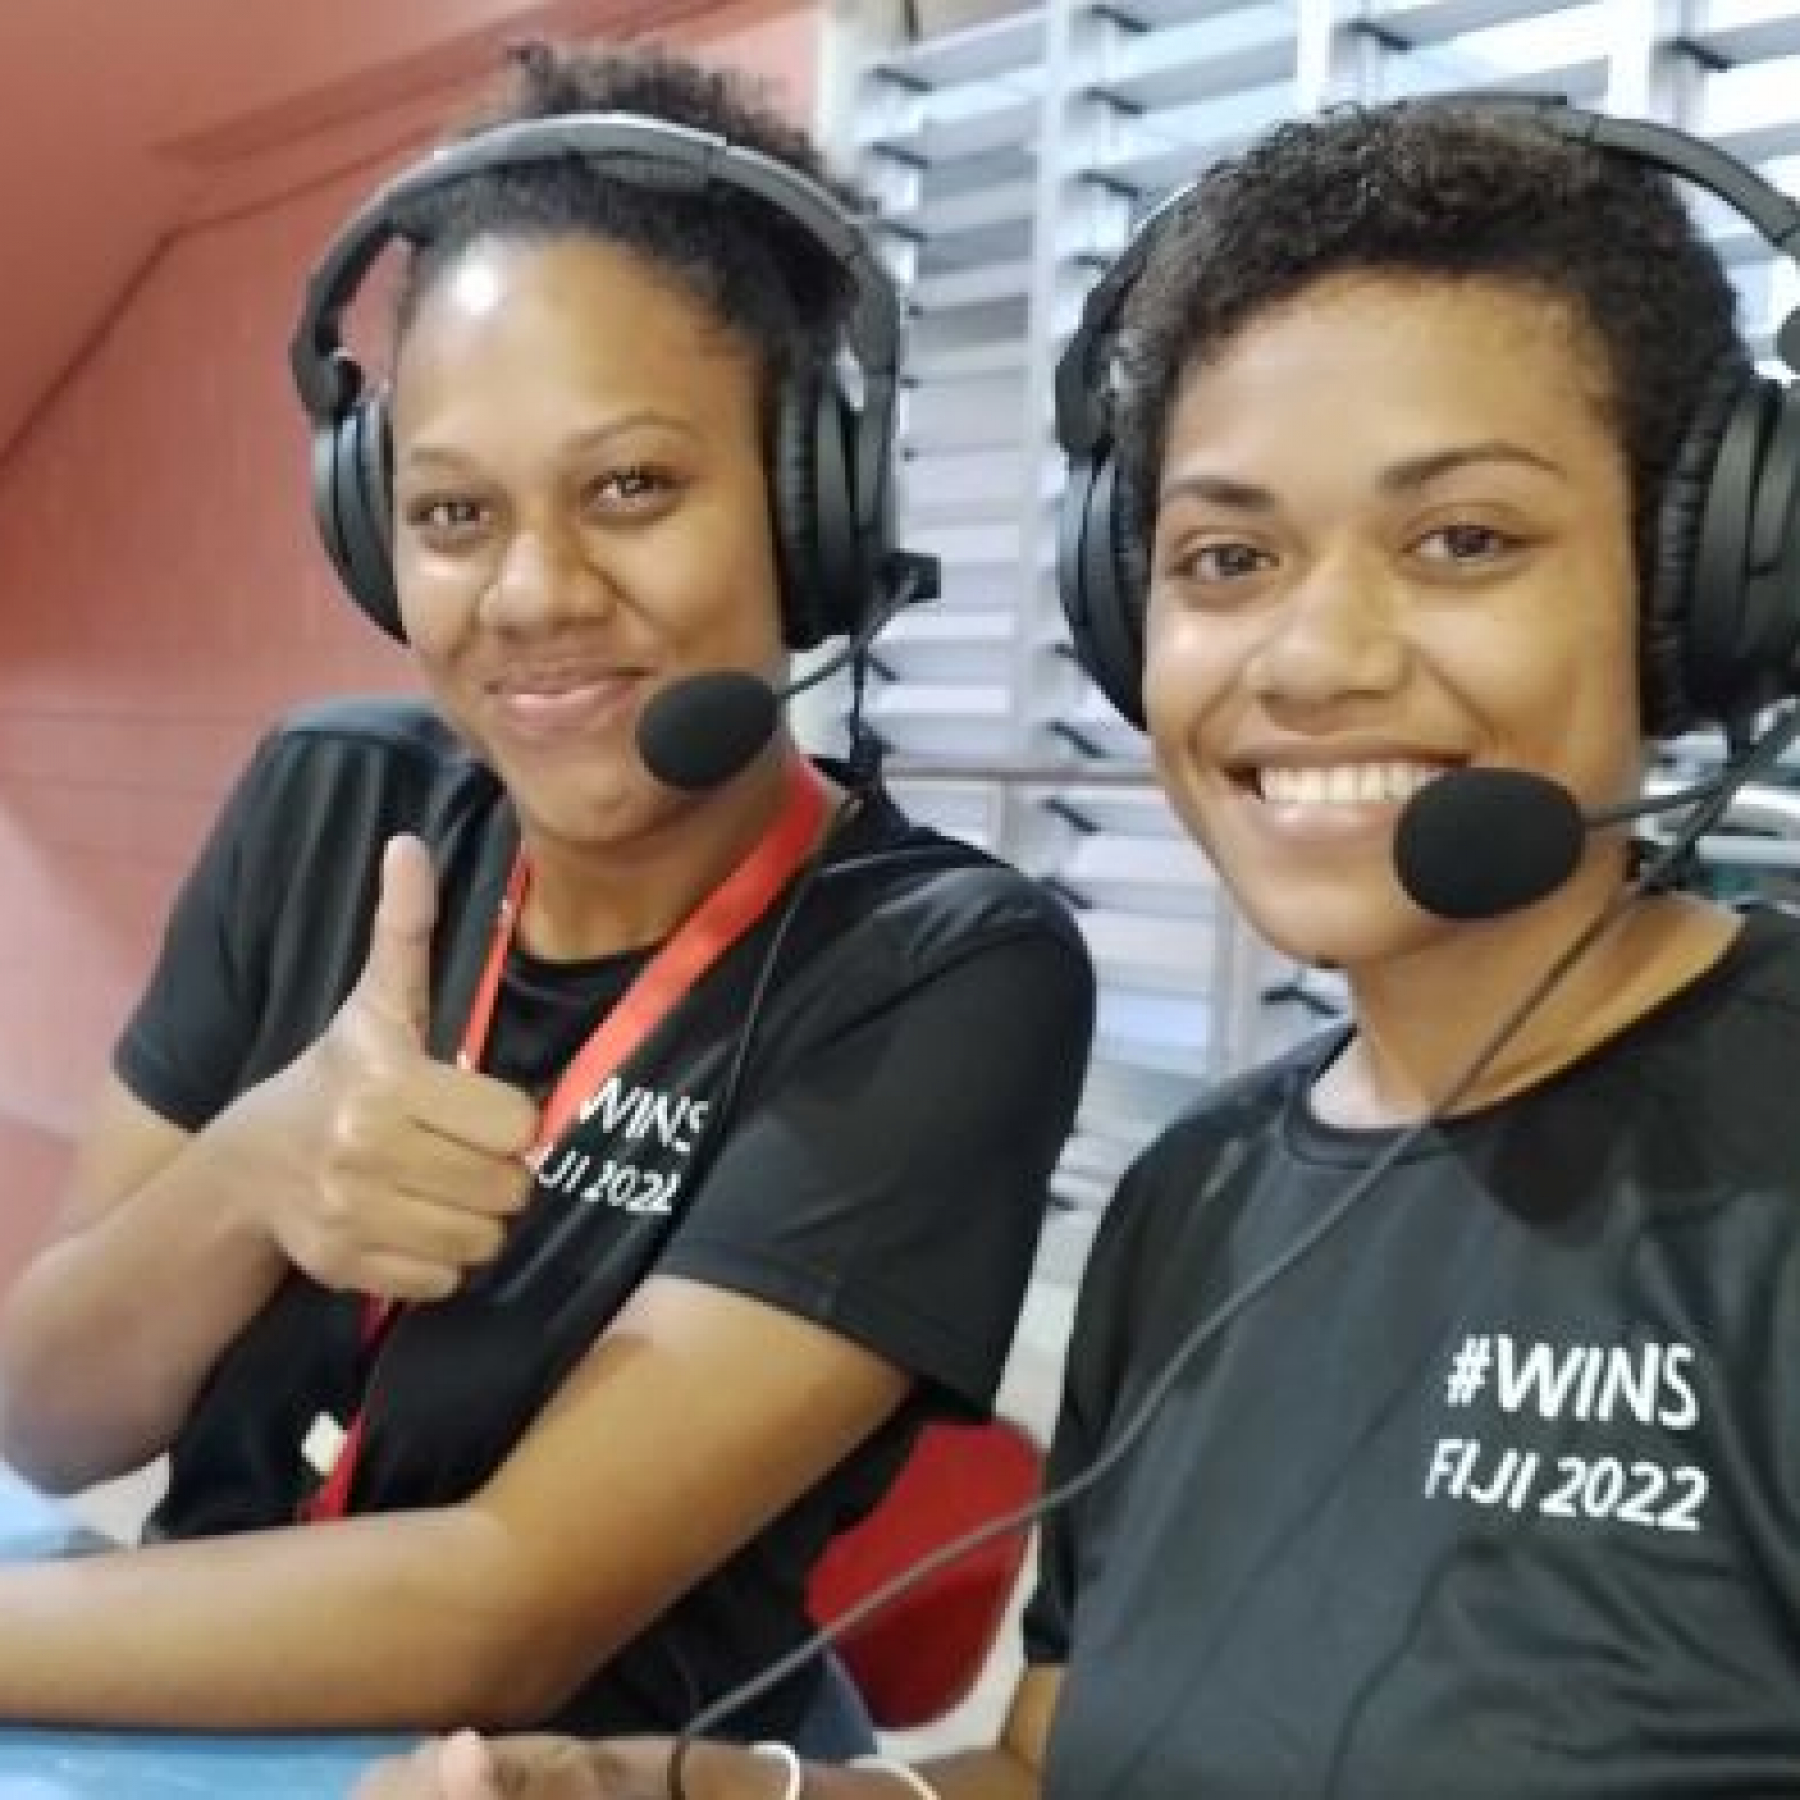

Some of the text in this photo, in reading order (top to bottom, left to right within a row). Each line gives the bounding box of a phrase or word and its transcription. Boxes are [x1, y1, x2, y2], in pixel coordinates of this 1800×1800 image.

[1447, 1333, 1700, 1429] #WINS
[1423, 1438, 1710, 1530] FIJI 2022
